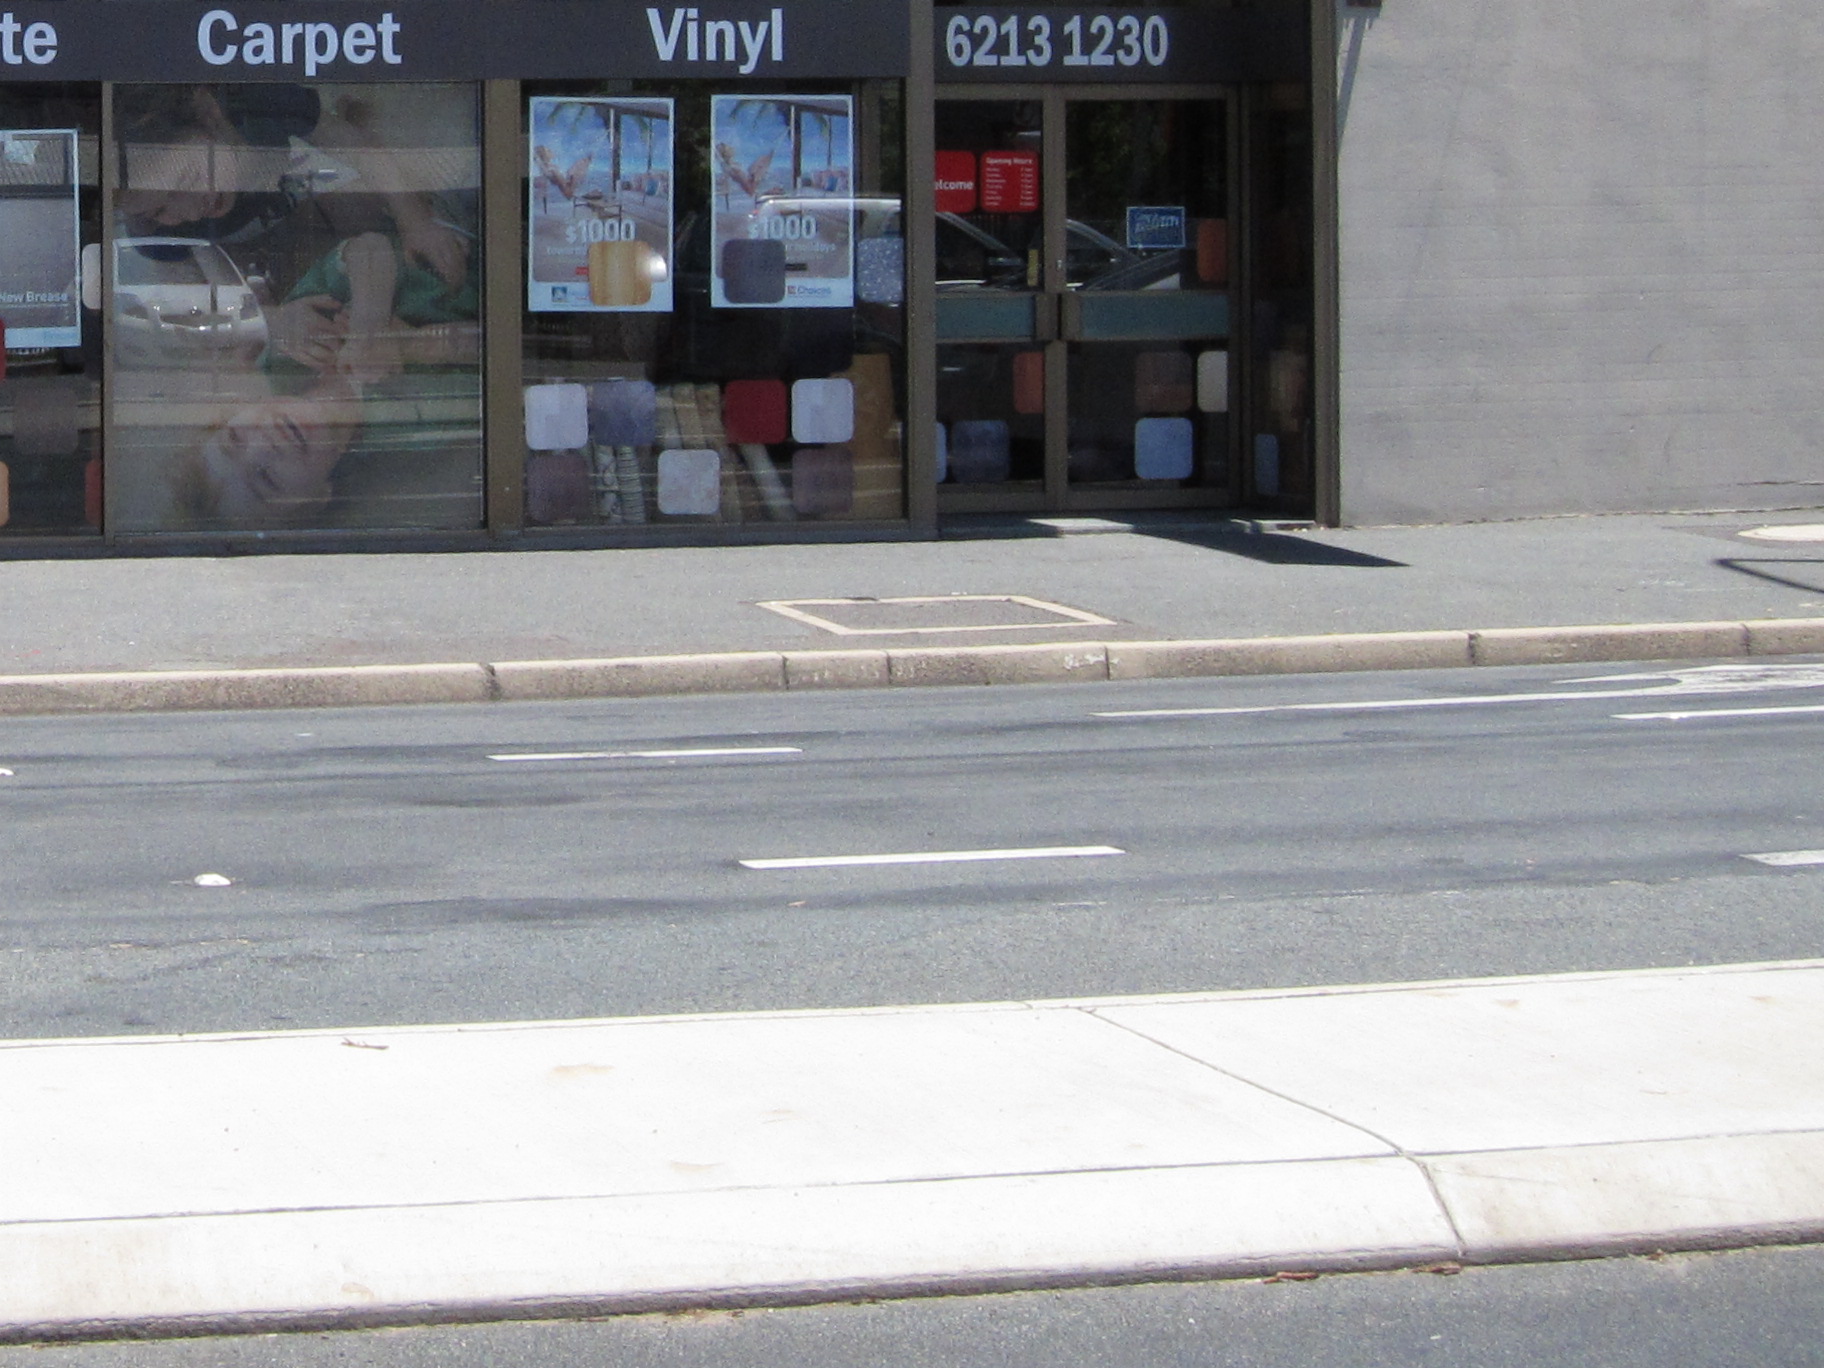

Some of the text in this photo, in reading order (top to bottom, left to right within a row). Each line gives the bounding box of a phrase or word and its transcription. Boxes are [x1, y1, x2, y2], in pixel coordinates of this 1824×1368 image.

[198, 10, 402, 76] Carpet
[647, 8, 783, 74] Vinyl
[945, 15, 1169, 66] 6213 1230
[565, 218, 636, 244] $1000
[748, 215, 817, 241] $1000
